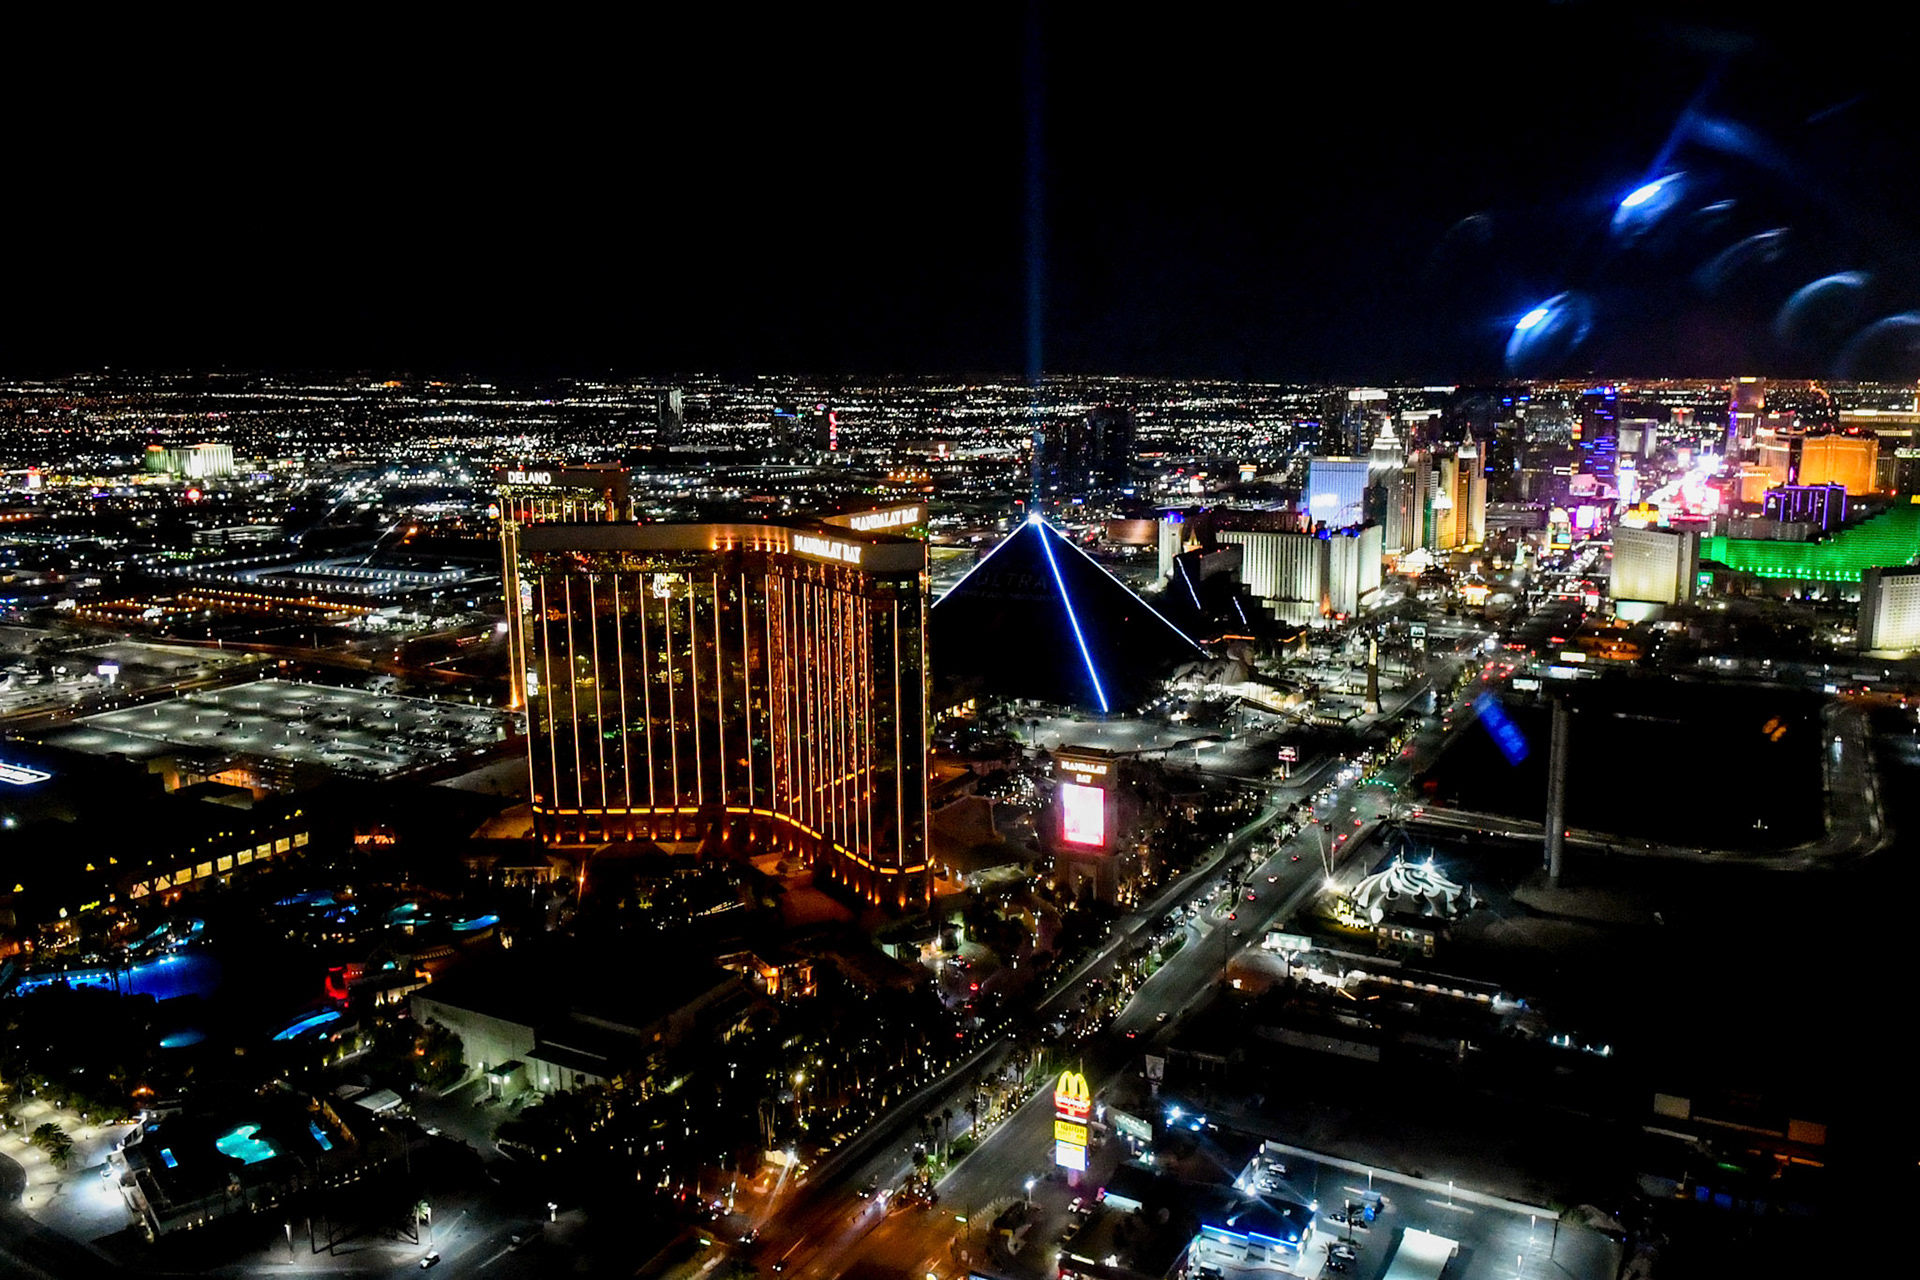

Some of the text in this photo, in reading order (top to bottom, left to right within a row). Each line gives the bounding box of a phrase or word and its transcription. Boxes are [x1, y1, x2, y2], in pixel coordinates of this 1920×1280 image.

[508, 471, 551, 485] DELANO
[850, 507, 919, 531] MANDALAY BAY
[794, 534, 862, 564] MANDALAY BAY
[1061, 760, 1107, 775] MANDALAY
[1076, 773, 1092, 784] BAY
